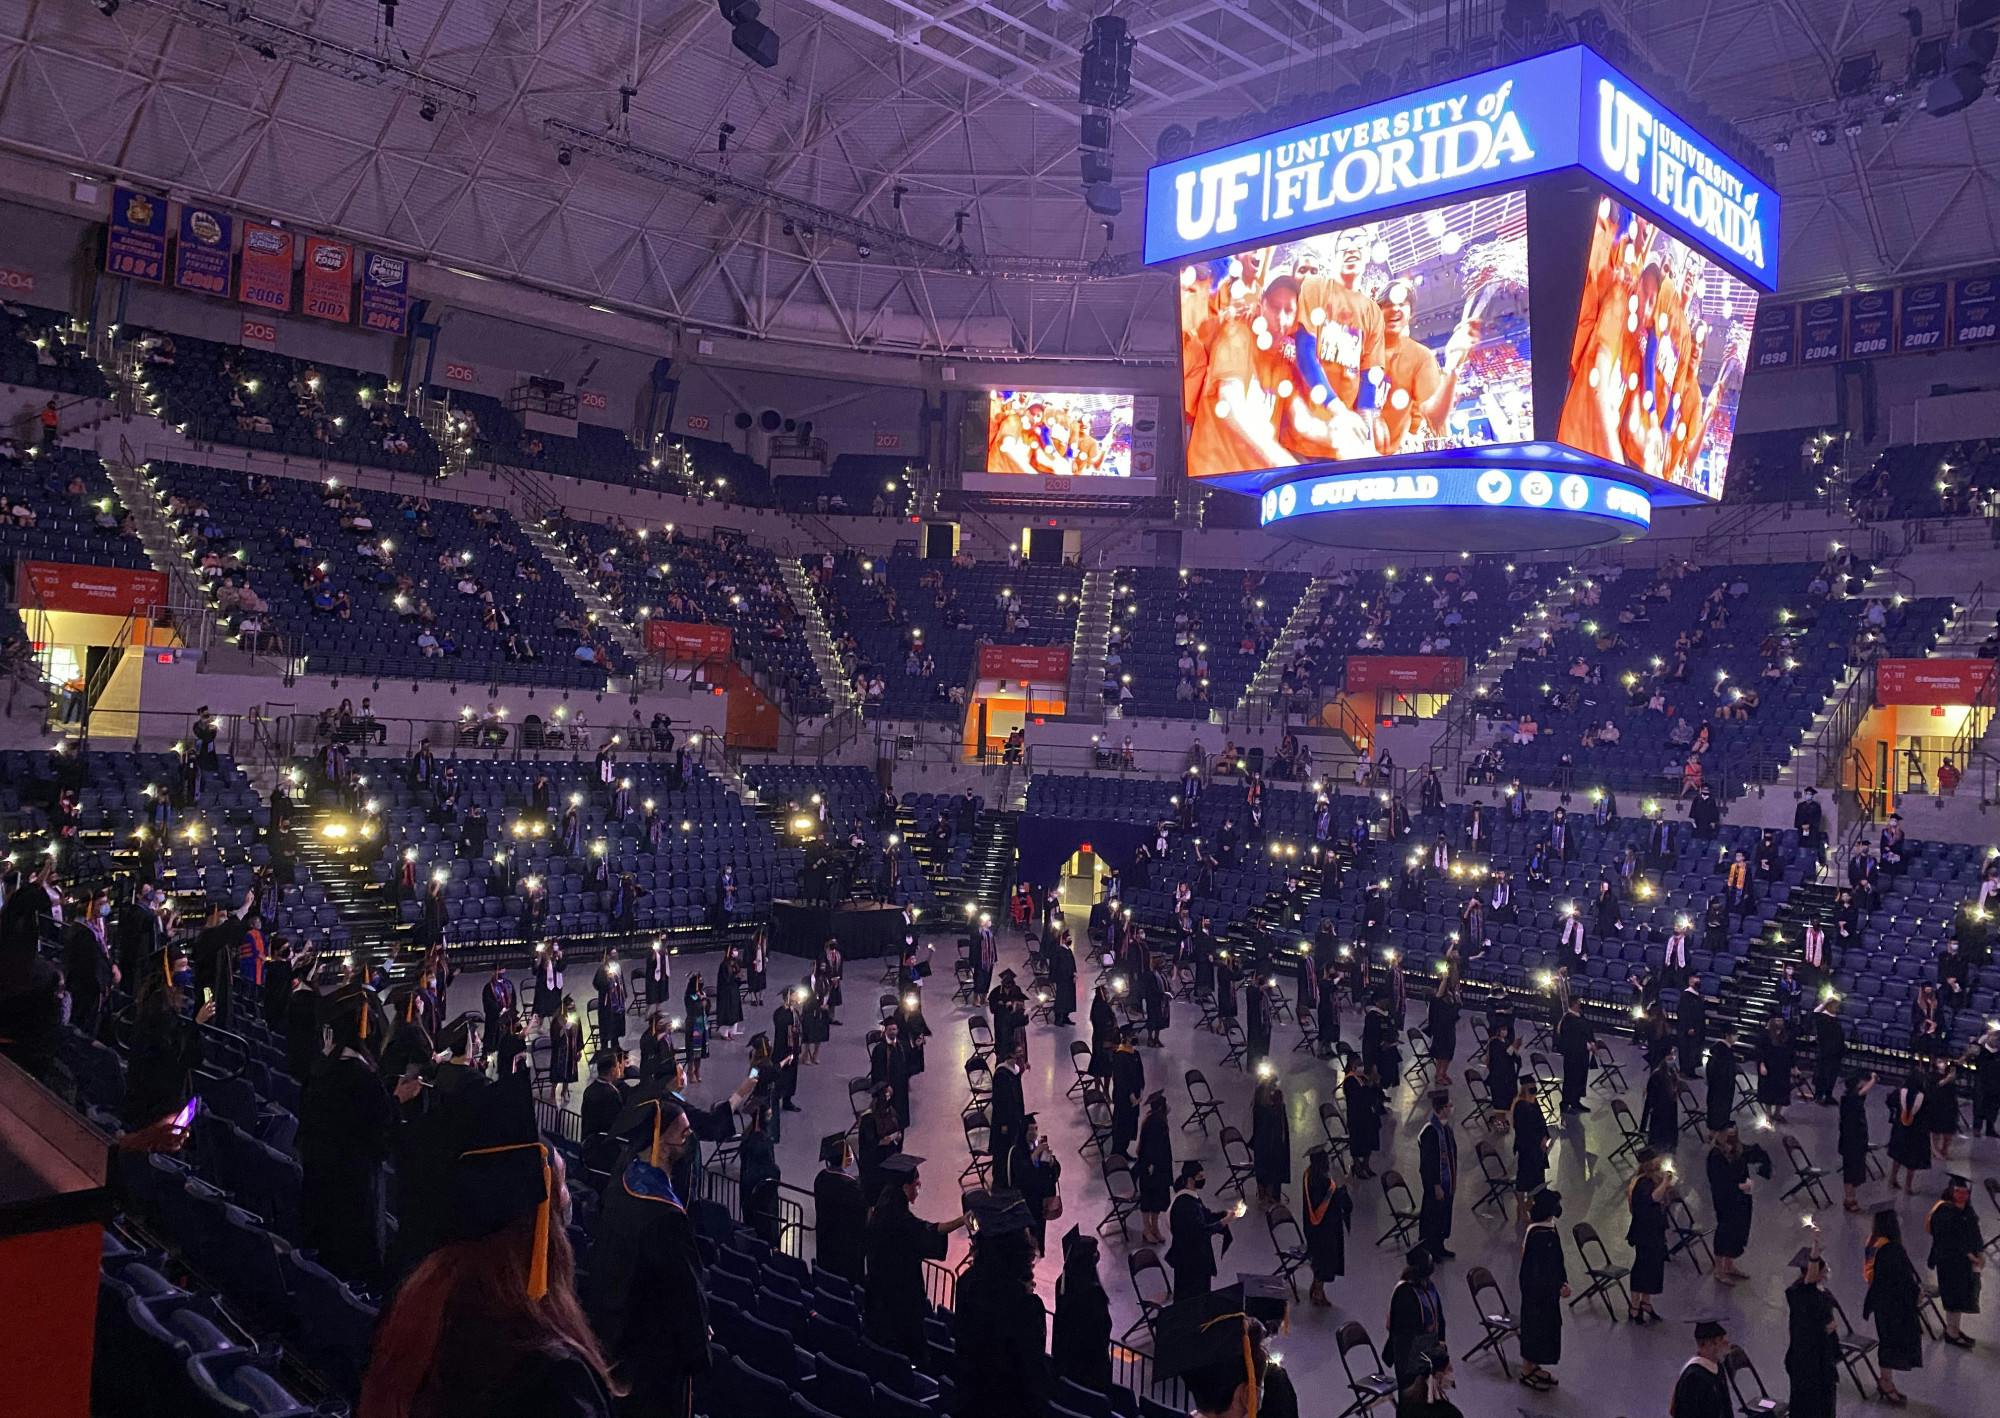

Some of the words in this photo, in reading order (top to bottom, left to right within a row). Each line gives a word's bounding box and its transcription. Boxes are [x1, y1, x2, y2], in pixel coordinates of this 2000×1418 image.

[1275, 94, 1468, 169] UNIVERSITY
[1476, 79, 1514, 122] of
[1598, 78, 1653, 185] UF
[1272, 110, 1535, 221] FLORIDA
[1658, 123, 1744, 204] UNIVERSITY
[1174, 152, 1262, 242] UF
[1657, 150, 1765, 270] FLORIDA
[314, 253, 342, 268] FOUR
[380, 259, 401, 271] FINAL
[0, 271, 33, 289] 204
[245, 285, 285, 306] 2006
[308, 299, 345, 317] 2007
[244, 323, 275, 340] 205
[1904, 331, 1940, 347] 2007
[1959, 324, 1996, 341] 2008
[1805, 345, 1838, 360] 2004
[1854, 338, 1888, 353] 2006
[1760, 351, 1788, 366] 1998
[446, 366, 473, 381] 206
[582, 393, 606, 408] 206
[688, 416, 709, 429] 207
[876, 435, 899, 447] 207
[1045, 478, 1070, 491] 208
[1311, 475, 1439, 506] #UFGRAD
